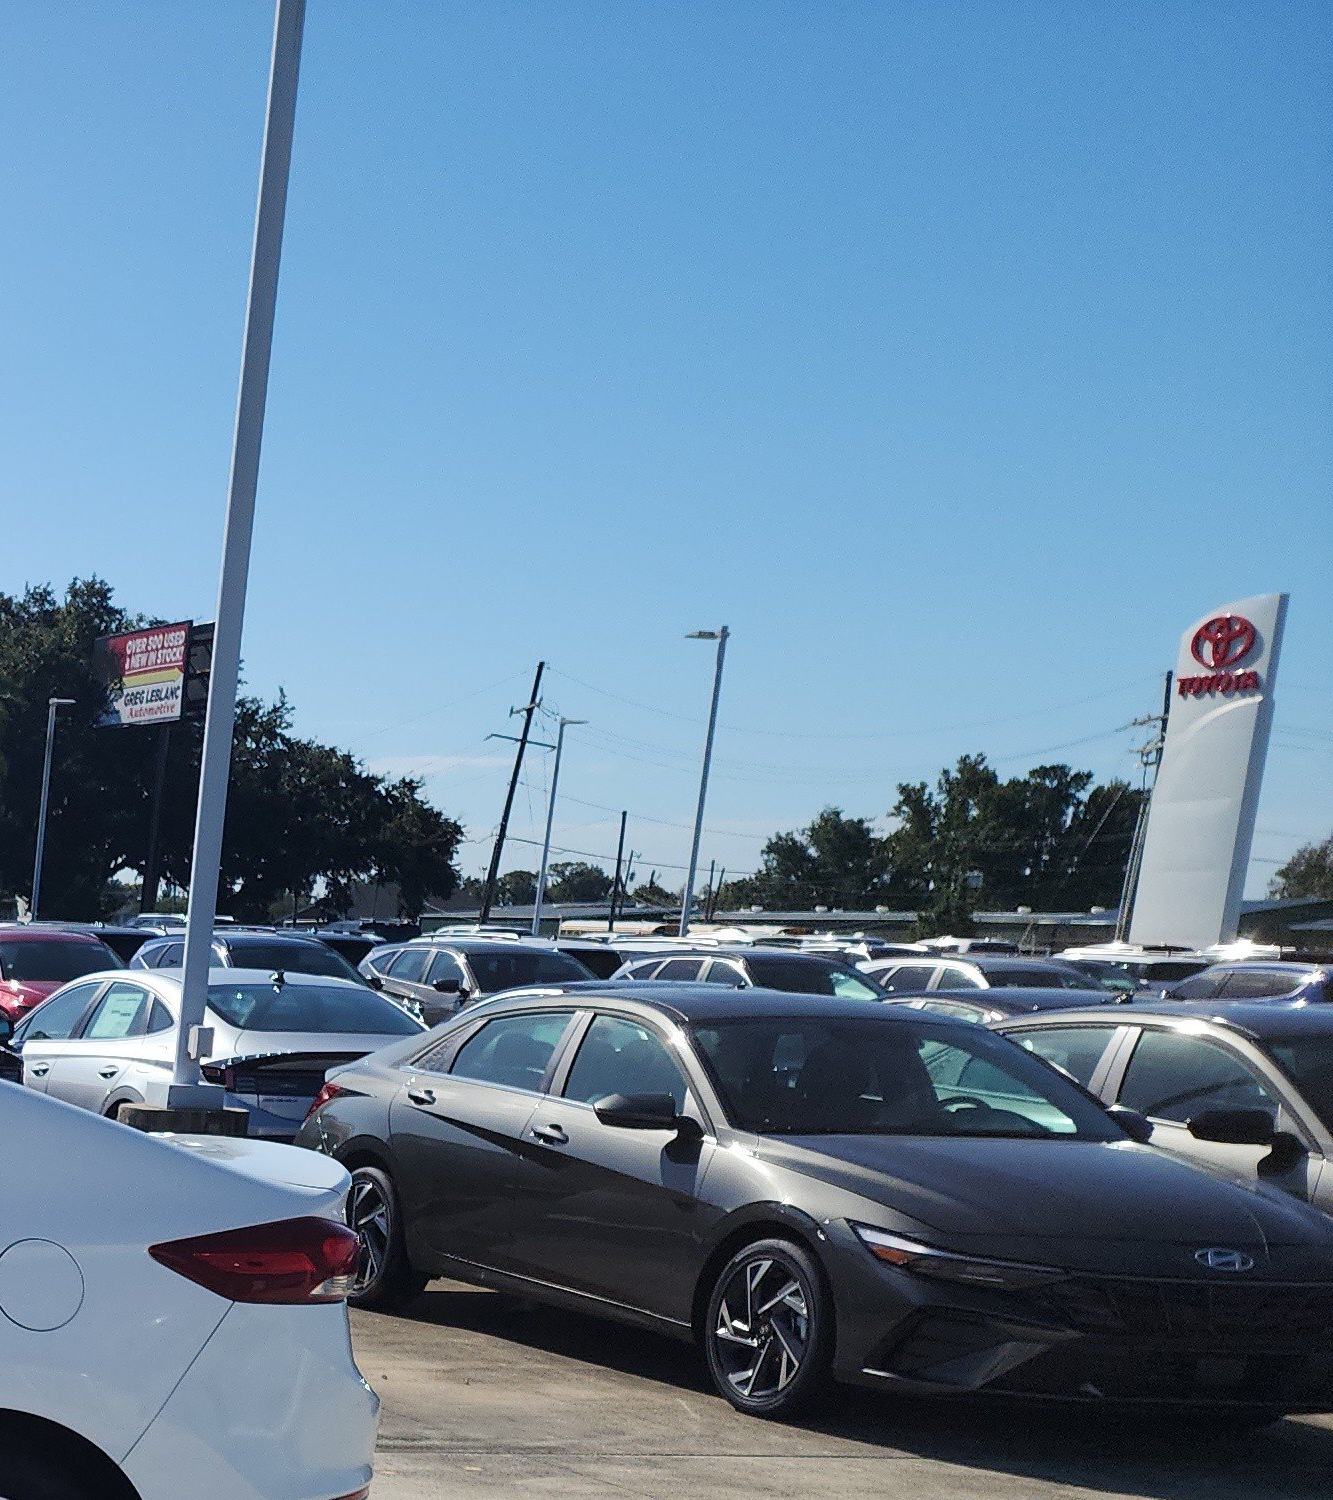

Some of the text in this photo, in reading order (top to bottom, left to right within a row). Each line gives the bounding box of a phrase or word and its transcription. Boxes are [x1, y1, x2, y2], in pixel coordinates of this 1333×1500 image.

[126, 638, 147, 655] OVER
[164, 631, 185, 647] USED
[131, 653, 148, 668] NEW
[1177, 670, 1259, 696] TOYOTA
[124, 686, 180, 706] GREG LEBLANC
[128, 703, 175, 718] Automotive
